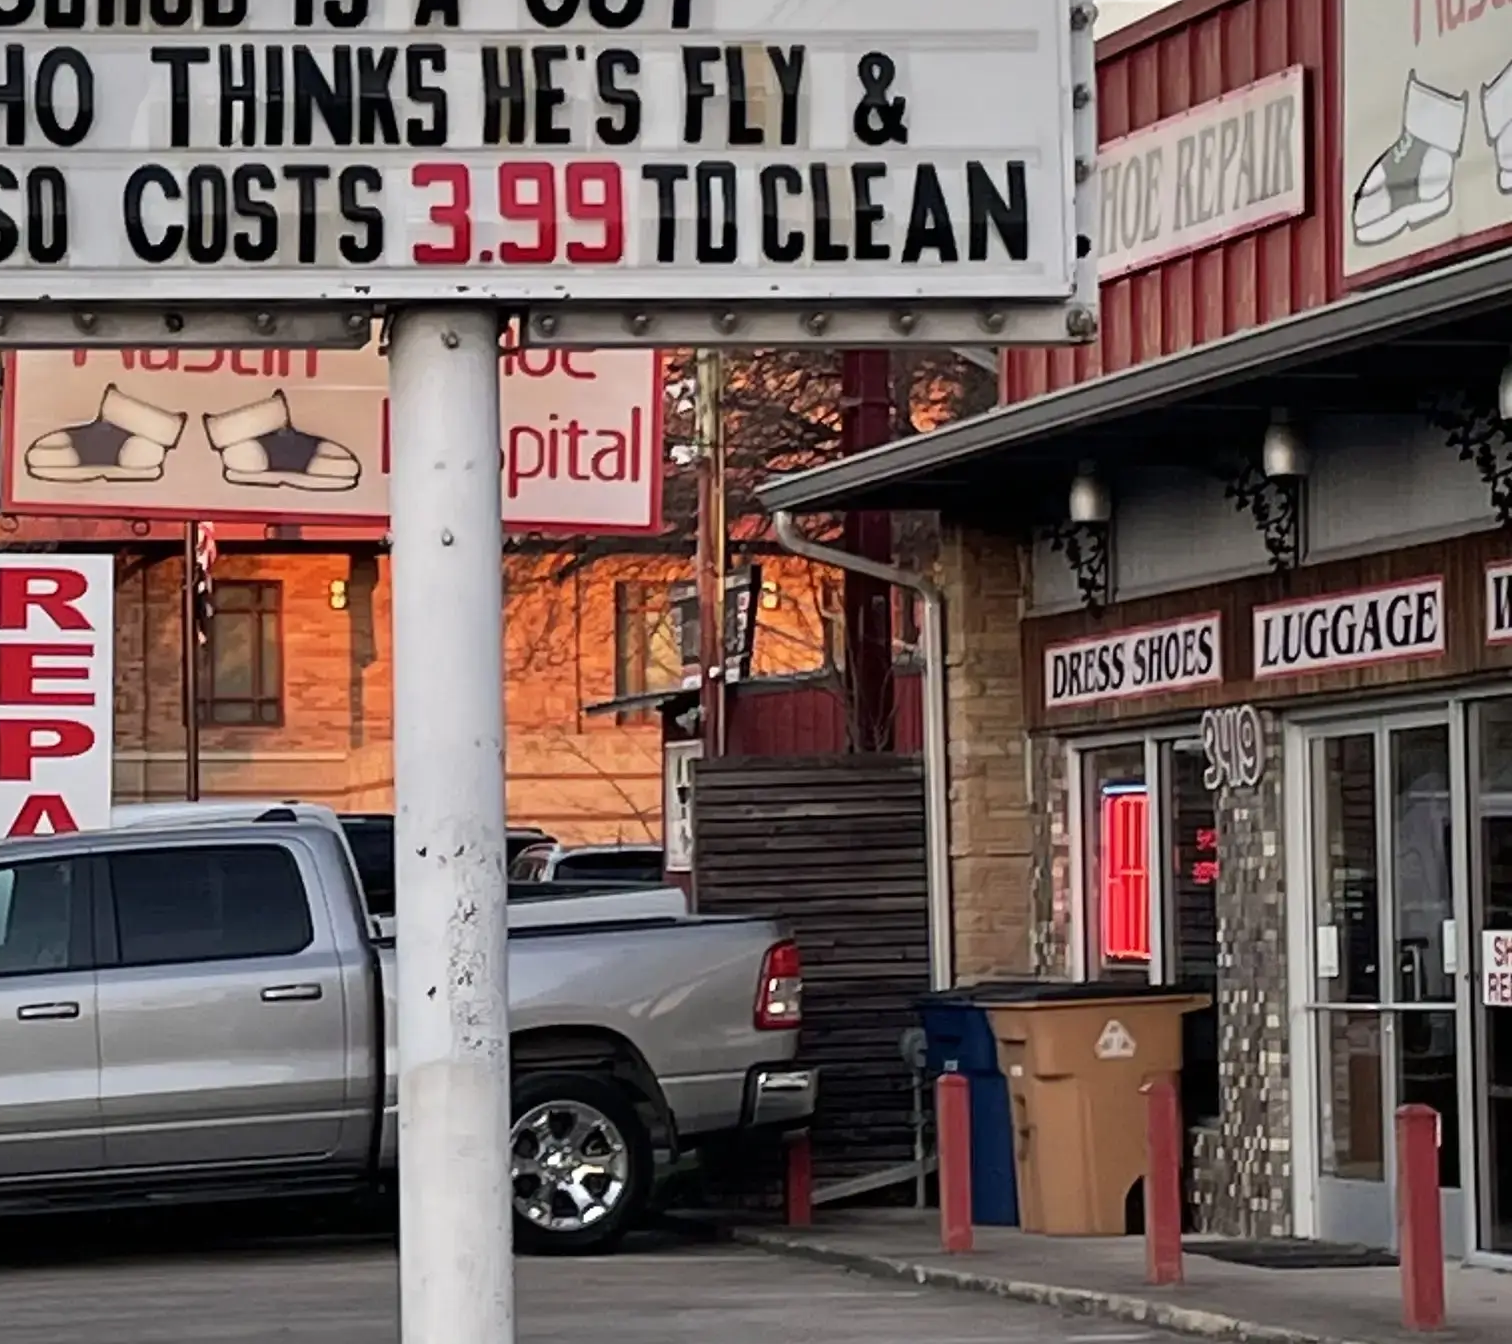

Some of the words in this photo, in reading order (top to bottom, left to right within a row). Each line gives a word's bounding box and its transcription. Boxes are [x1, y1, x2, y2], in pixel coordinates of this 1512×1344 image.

[150, 43, 447, 148] THINKS
[481, 44, 641, 146] HE'S
[682, 44, 806, 146] FLY
[853, 52, 908, 146] &
[124, 163, 384, 264] COSTS
[412, 161, 625, 266] 3.99
[1100, 147, 1161, 254] HOE
[1173, 95, 1294, 232] REPAIR
[1052, 643, 1125, 699] DRESS
[1133, 626, 1214, 686] SHOES
[1261, 591, 1438, 668] LUGGAGE
